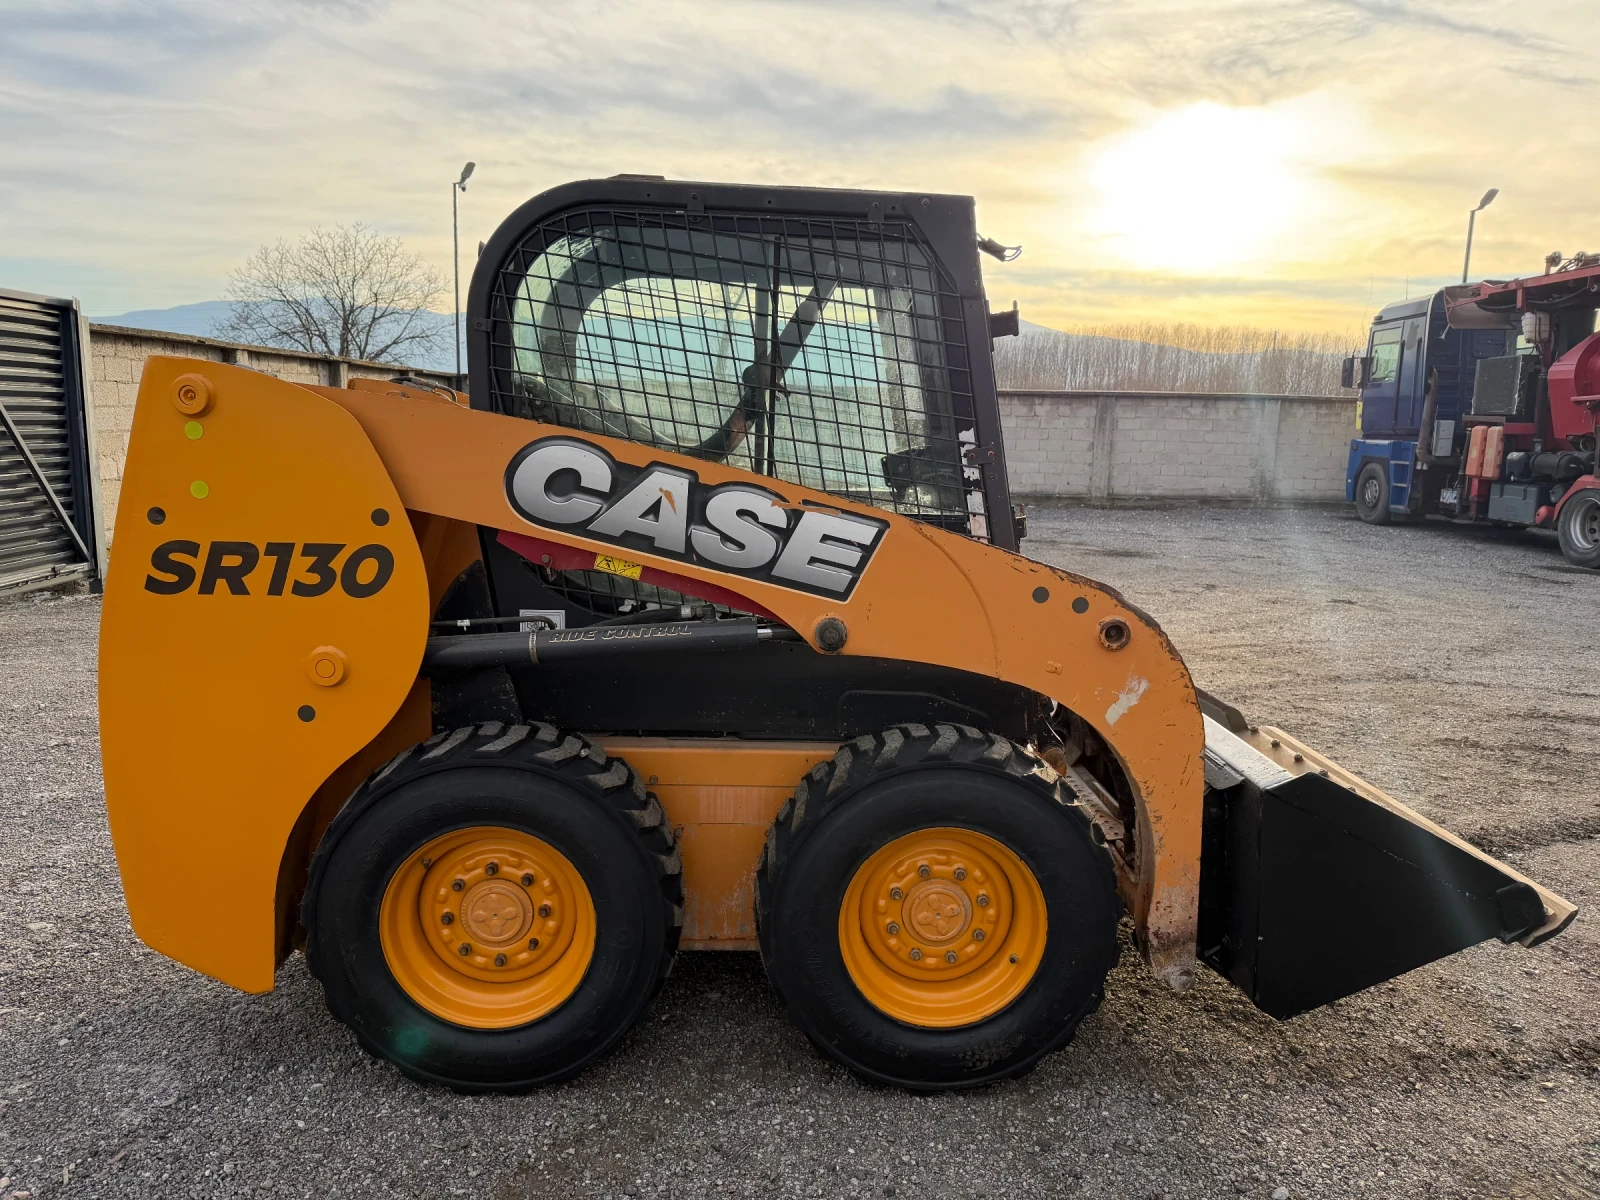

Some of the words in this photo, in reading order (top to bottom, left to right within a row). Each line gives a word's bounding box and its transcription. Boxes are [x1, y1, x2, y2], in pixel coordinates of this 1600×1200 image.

[509, 442, 884, 595] CASE
[144, 539, 395, 599] SR130
[549, 631, 598, 643] RIDE
[602, 625, 692, 640] CONTROL
